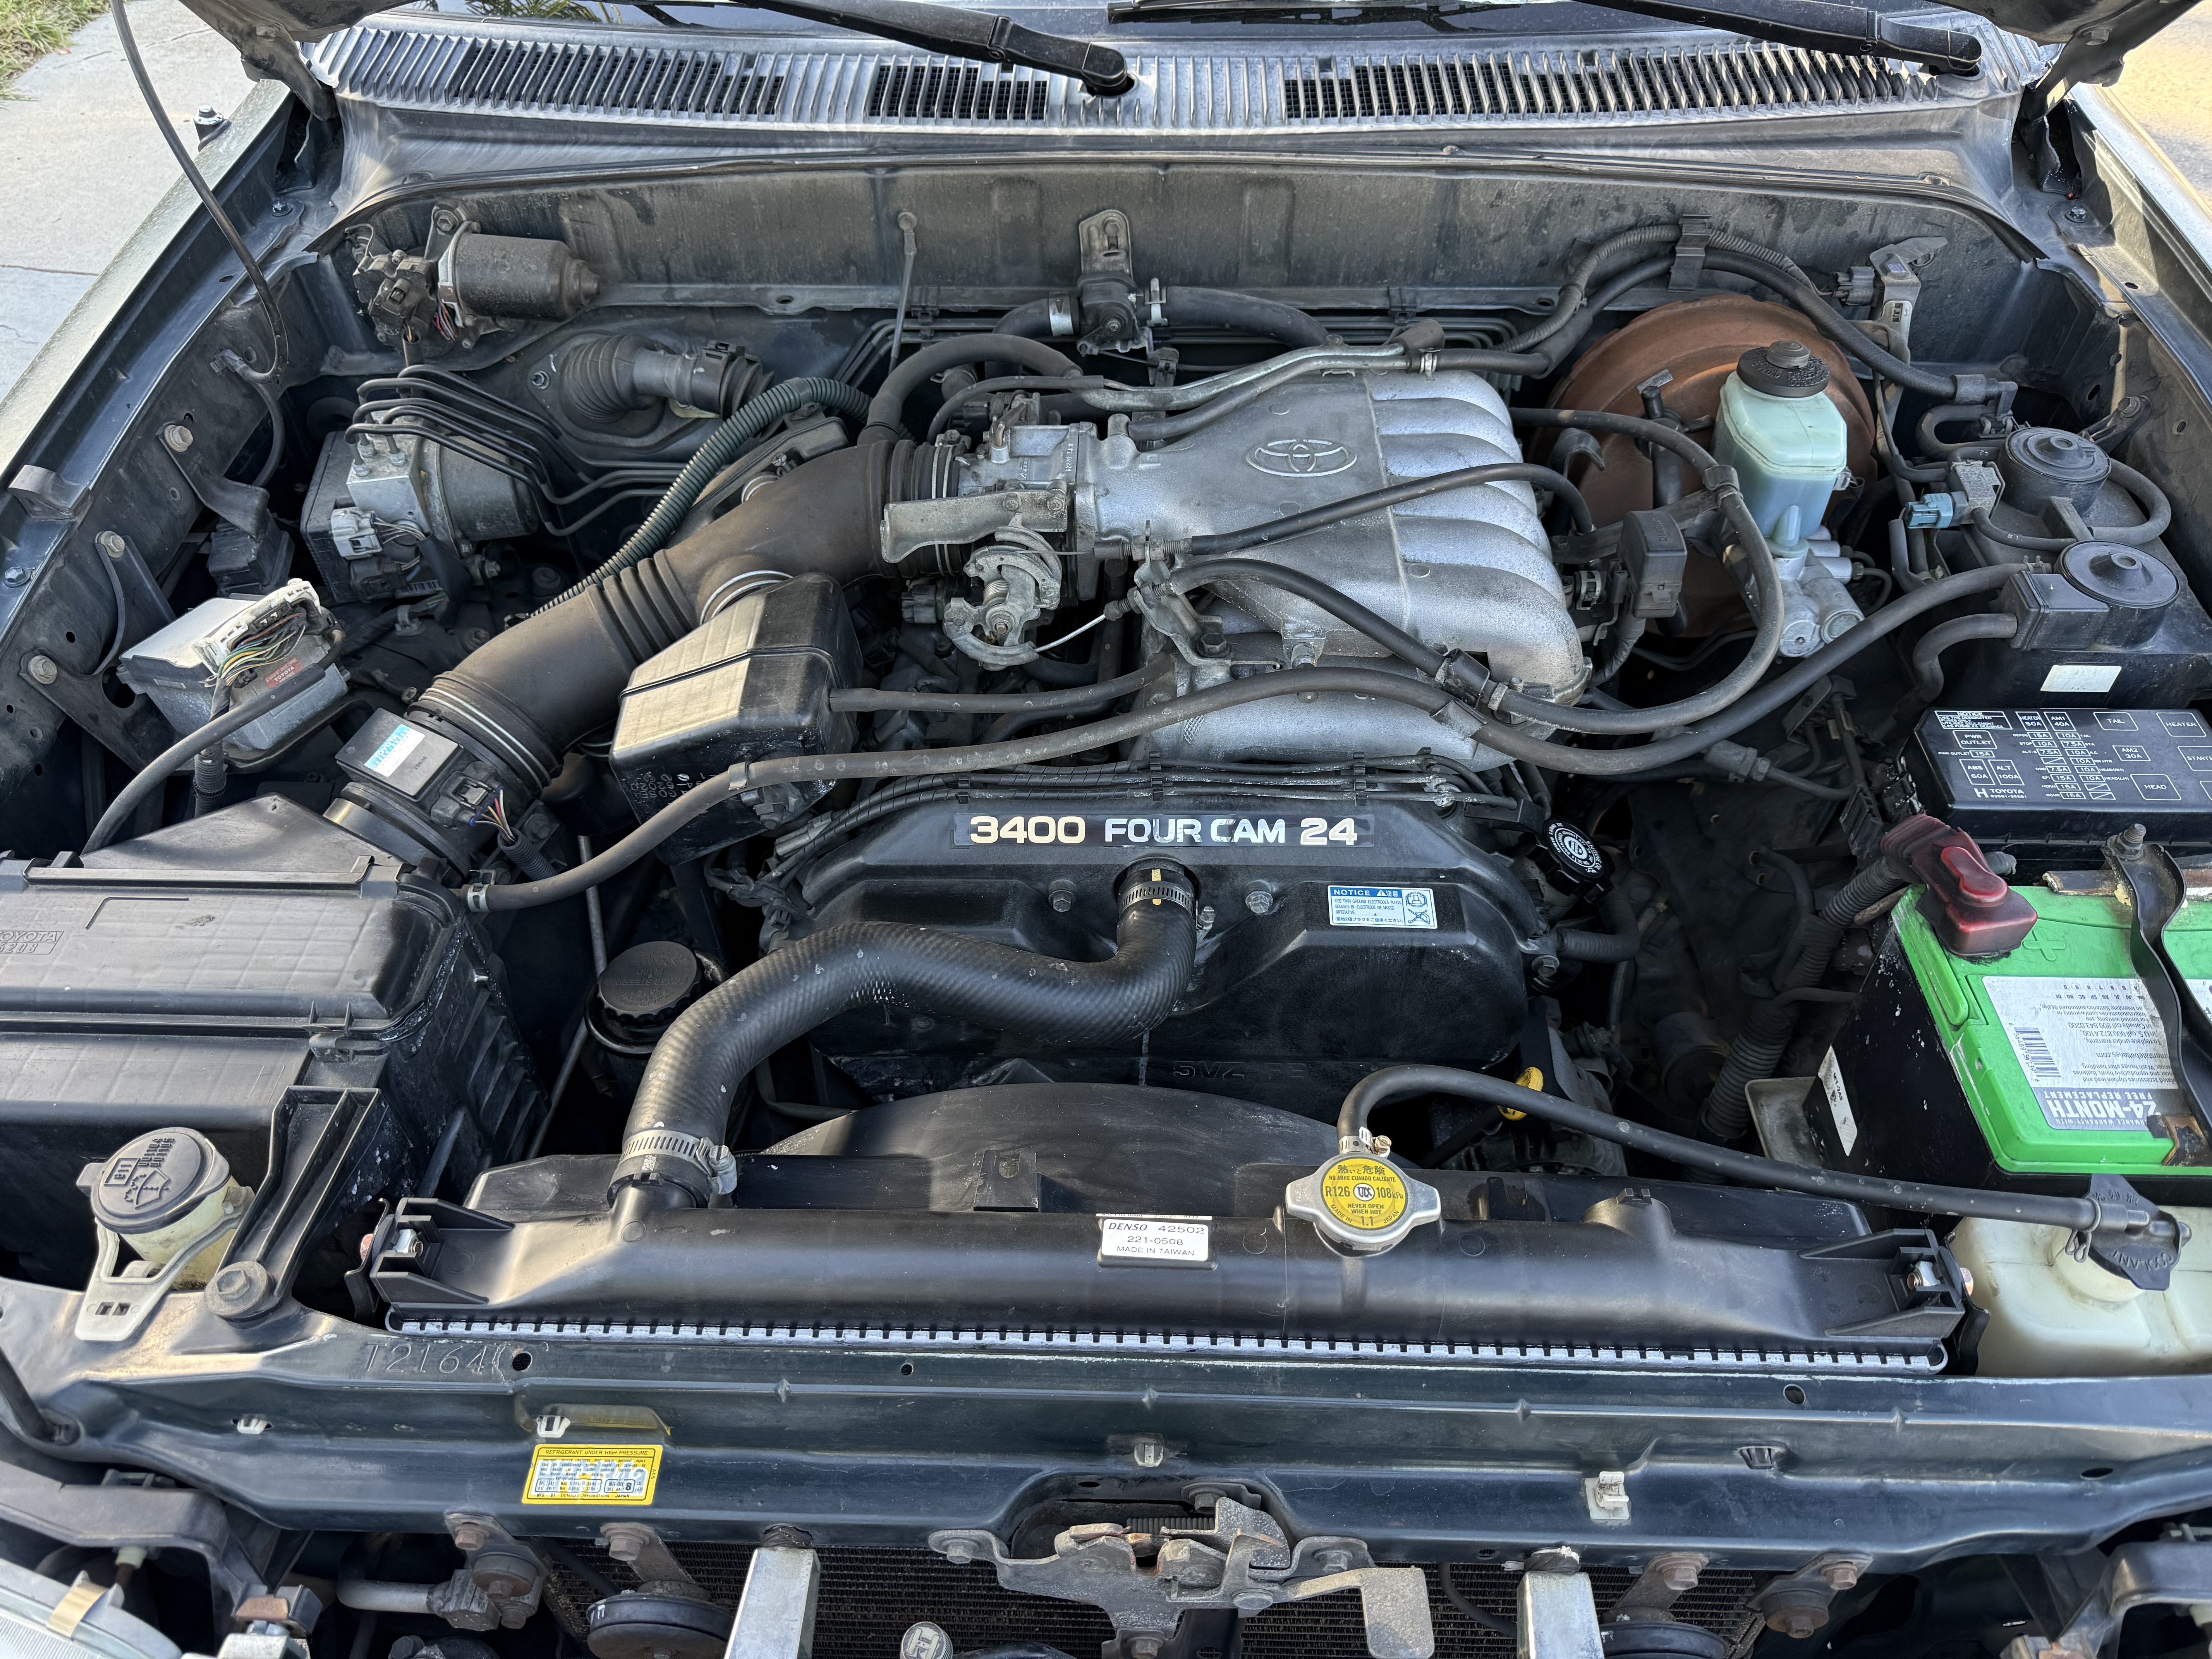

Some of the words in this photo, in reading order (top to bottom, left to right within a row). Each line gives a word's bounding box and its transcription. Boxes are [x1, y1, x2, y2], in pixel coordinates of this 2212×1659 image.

[969, 815, 1085, 844] 3400
[1105, 817, 1202, 844] FOUR
[1210, 817, 1286, 844] CAM
[1299, 817, 1358, 846] 24
[654, 977, 688, 985] POWER
[2043, 1091, 2122, 1099] REPLACEMENT
[2124, 1092, 2152, 1100] FREE
[2045, 1099, 2160, 1118] 24-MONTH
[1338, 1165, 1386, 1175] 熱いと危険
[1326, 1186, 1350, 1197] R126
[1330, 1204, 1345, 1219] MADE
[1345, 1215, 1353, 1223] IN
[1383, 1210, 1400, 1224] JAPAN
[1360, 1216, 1374, 1227] 1.1
[1108, 1223, 1147, 1231] DENSO
[1158, 1226, 1204, 1234] 42502
[1127, 1236, 1183, 1245] 221-0508
[2111, 1250, 2172, 1271] COOLANT
[364, 1343, 488, 1374] T2164
[625, 1482, 632, 1491] 8
